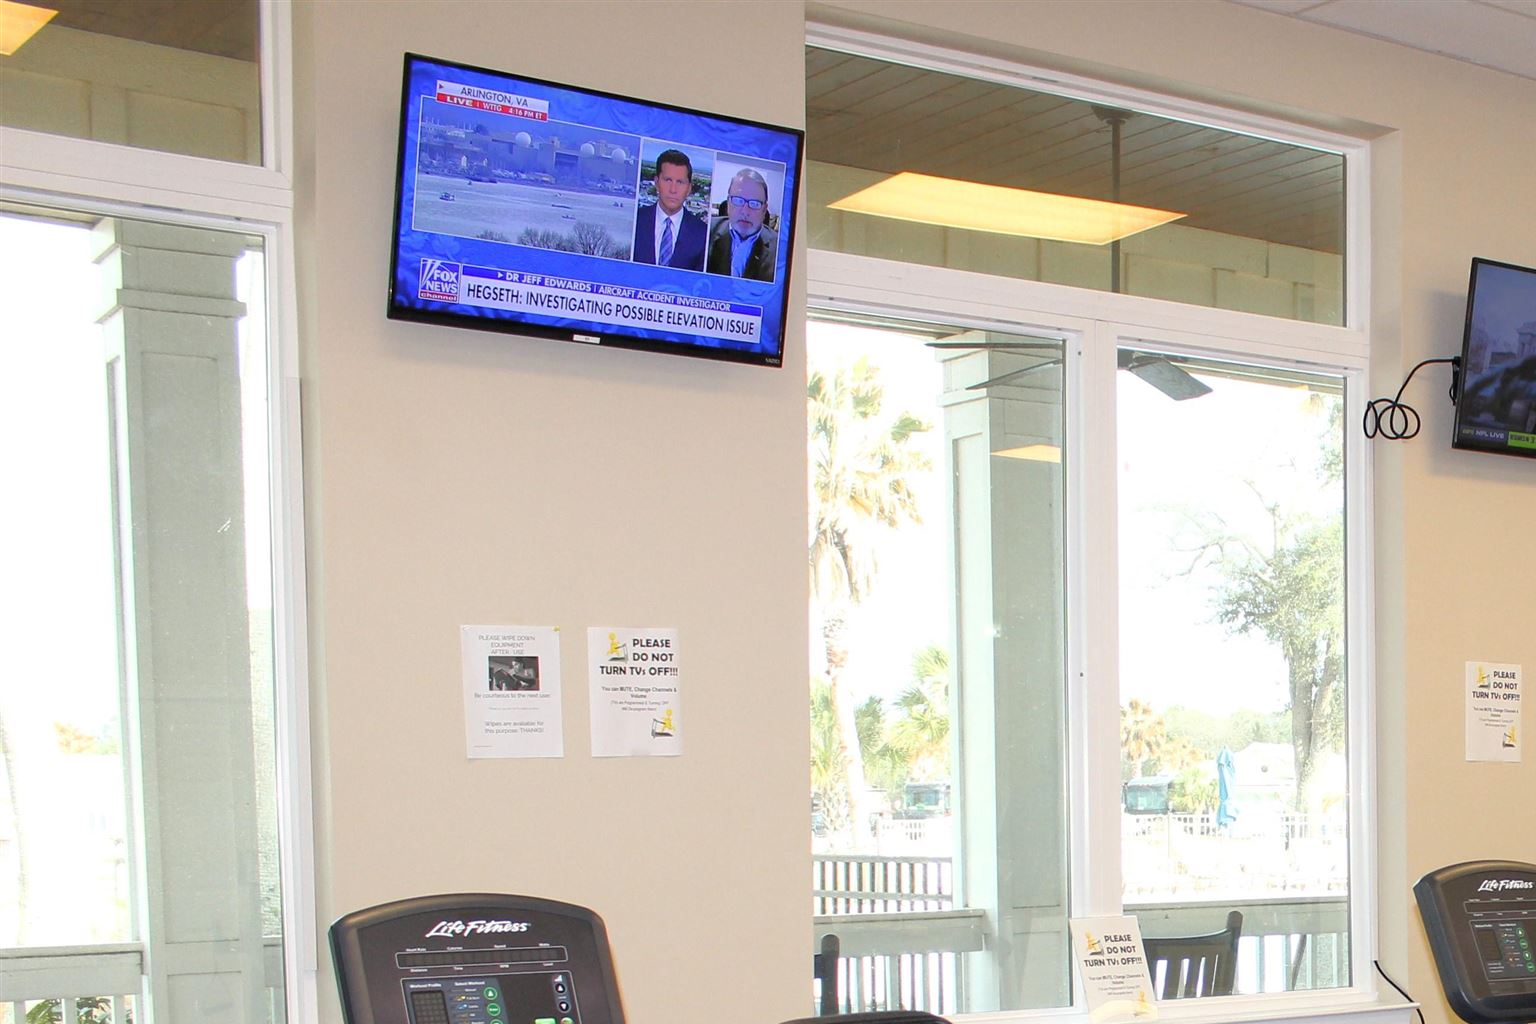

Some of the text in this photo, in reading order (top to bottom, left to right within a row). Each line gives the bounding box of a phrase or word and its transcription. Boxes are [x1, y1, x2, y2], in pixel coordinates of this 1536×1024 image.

[460, 86, 528, 107] ARLINGTON, VA
[446, 95, 473, 107] LIVE
[508, 108, 523, 117] 4:16
[524, 110, 534, 119] PM
[535, 112, 543, 120] ET
[433, 269, 457, 283] FOX
[426, 281, 457, 295] NEWS
[506, 272, 731, 312] DR JEFF EDWARDS AIRCRAFT ACCIDENT INVESTIGATOR
[421, 291, 457, 302] channel
[467, 283, 755, 336] HEGSETH: INVESTIGATING POSSIBLE ELEVATION ISSUE
[632, 638, 671, 648] PLEASE
[632, 652, 674, 662] DO NOT
[599, 665, 678, 676] TURN TVs OFF!!!
[1493, 671, 1516, 680] PLEASE
[1493, 681, 1518, 690] DO NOT
[1472, 691, 1489, 699] TURN
[1477, 879, 1534, 892] Life Fitness
[425, 920, 529, 938] Life Fitness
[1104, 934, 1132, 942] PLEASE
[1106, 945, 1136, 954] DO NOT
[1084, 959, 1105, 967] TURN
